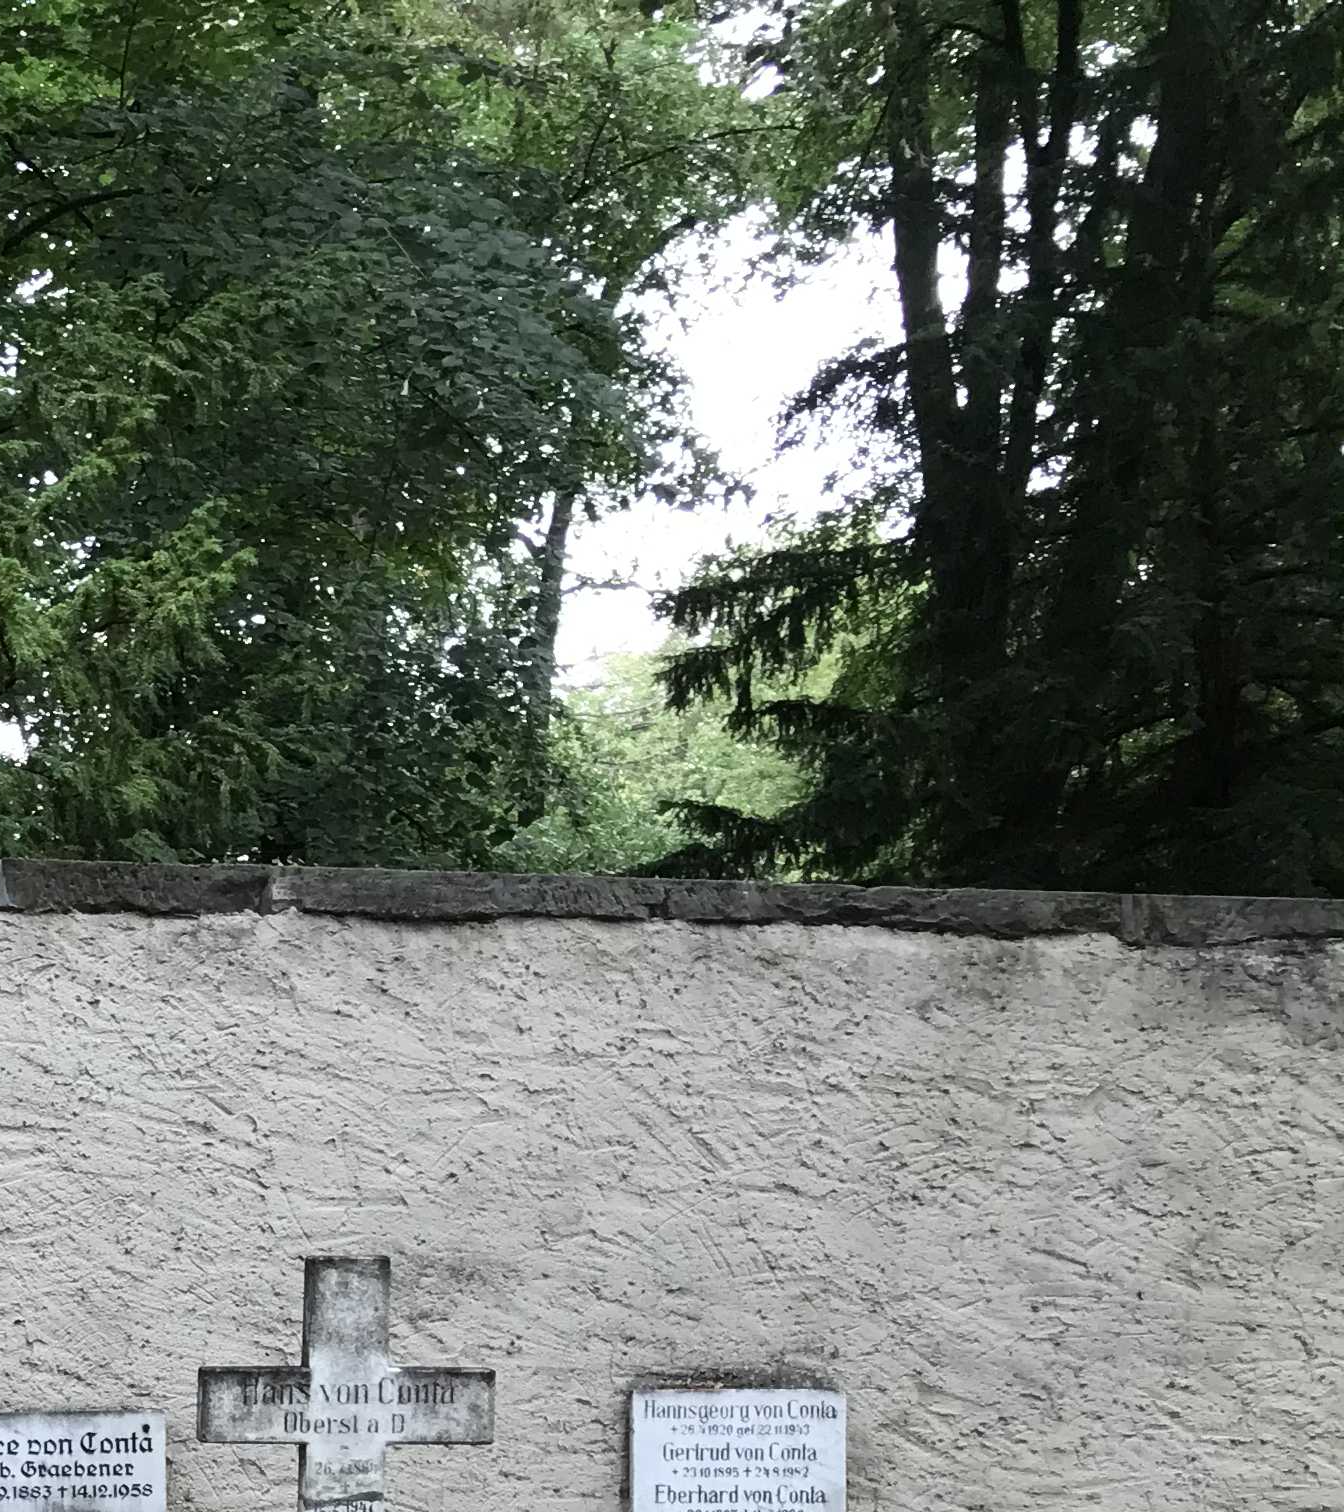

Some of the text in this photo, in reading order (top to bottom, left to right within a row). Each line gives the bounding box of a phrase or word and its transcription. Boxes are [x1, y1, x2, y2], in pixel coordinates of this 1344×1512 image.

[243, 1376, 455, 1405] Hans von Conta
[644, 1399, 838, 1423] Hannsgeorg von Conta
[284, 1411, 358, 1434] Oberst
[28, 1439, 73, 1455] von
[81, 1432, 153, 1455] Conta
[663, 1442, 817, 1462] Gertrud von Conta
[20, 1460, 134, 1479] Graebener
[71, 1483, 153, 1499] 14.12.1958
[655, 1484, 828, 1505] Eberhard von Conta
